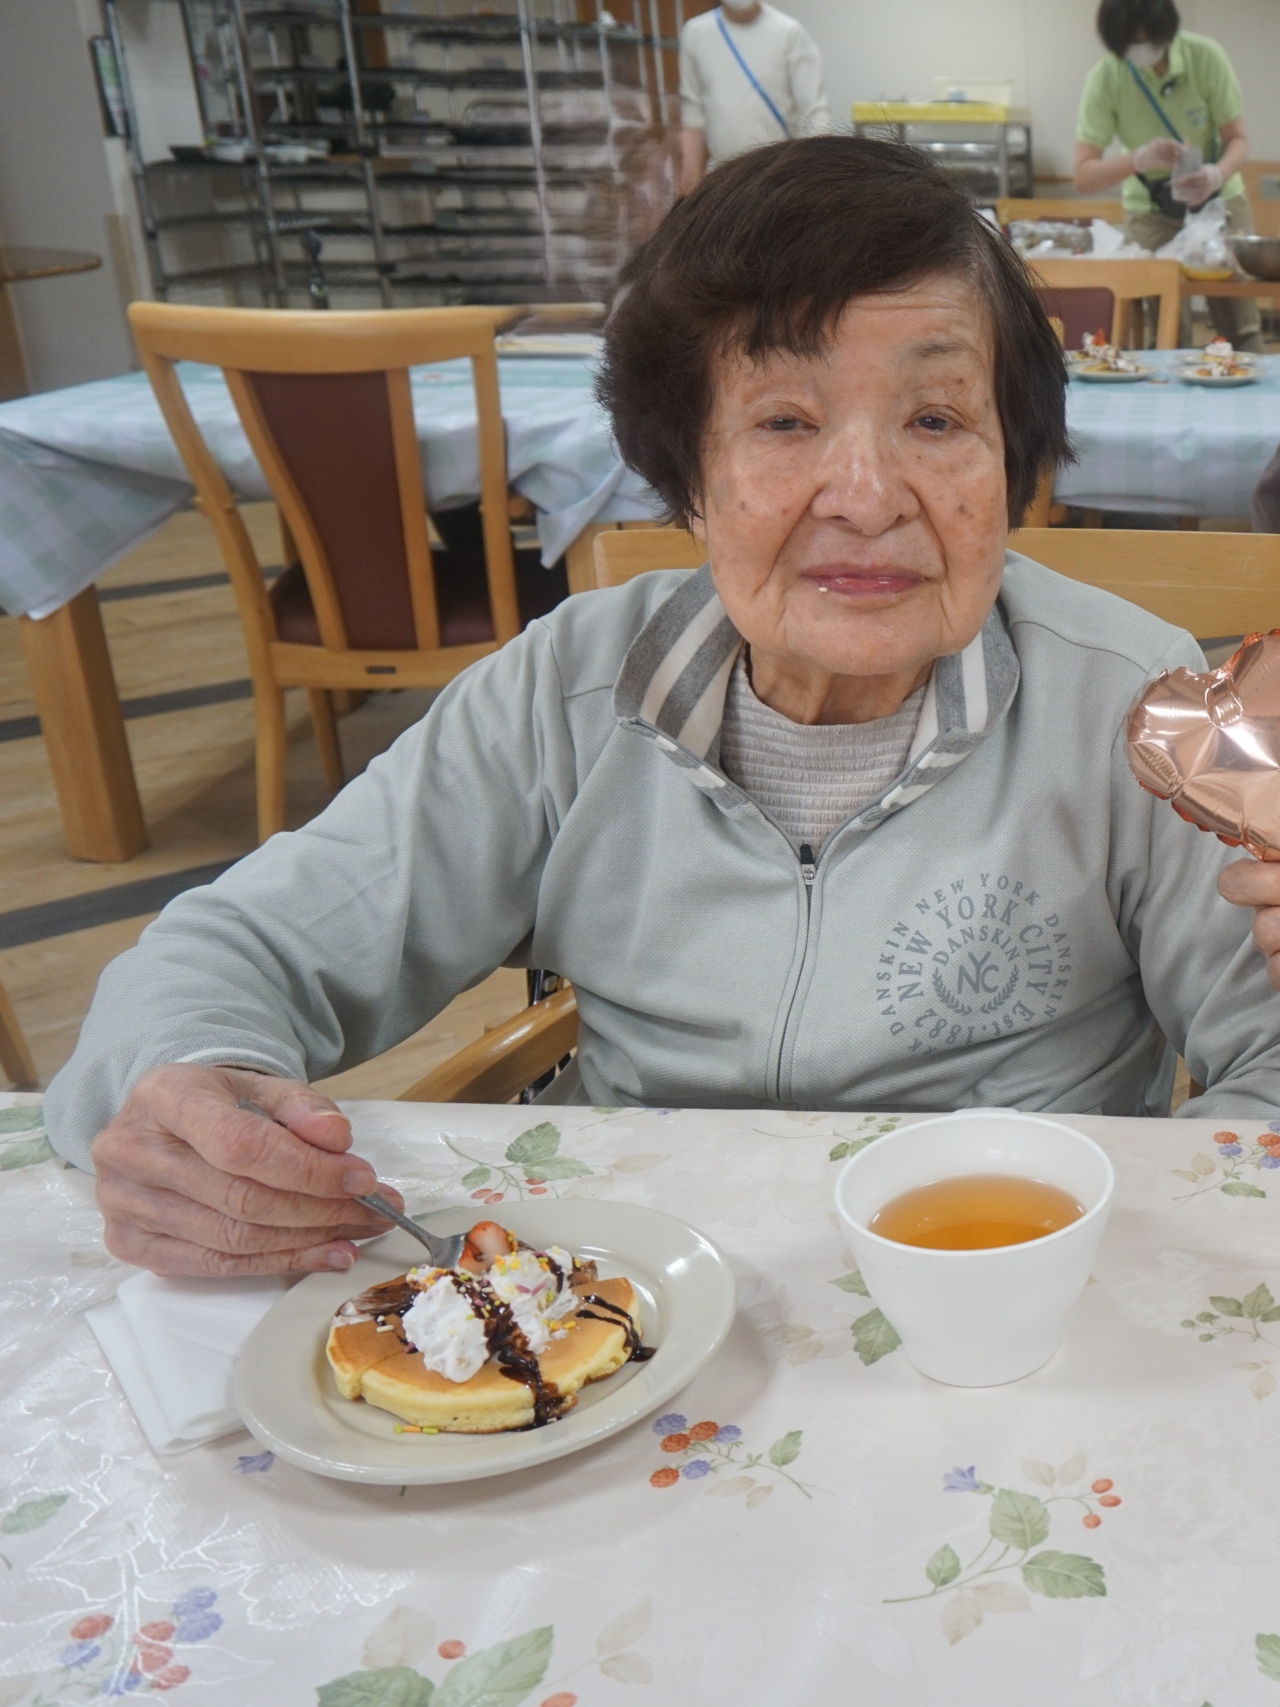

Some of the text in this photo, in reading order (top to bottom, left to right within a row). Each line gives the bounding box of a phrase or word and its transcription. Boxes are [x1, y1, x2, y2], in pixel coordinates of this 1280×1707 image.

[876, 873, 1072, 1036] DANSKIN NEW YORK DANSKIN
[897, 893, 1054, 1003] NEW YORK CITY
[932, 925, 1020, 967] DANSKIN
[957, 951, 1000, 995] NYC
